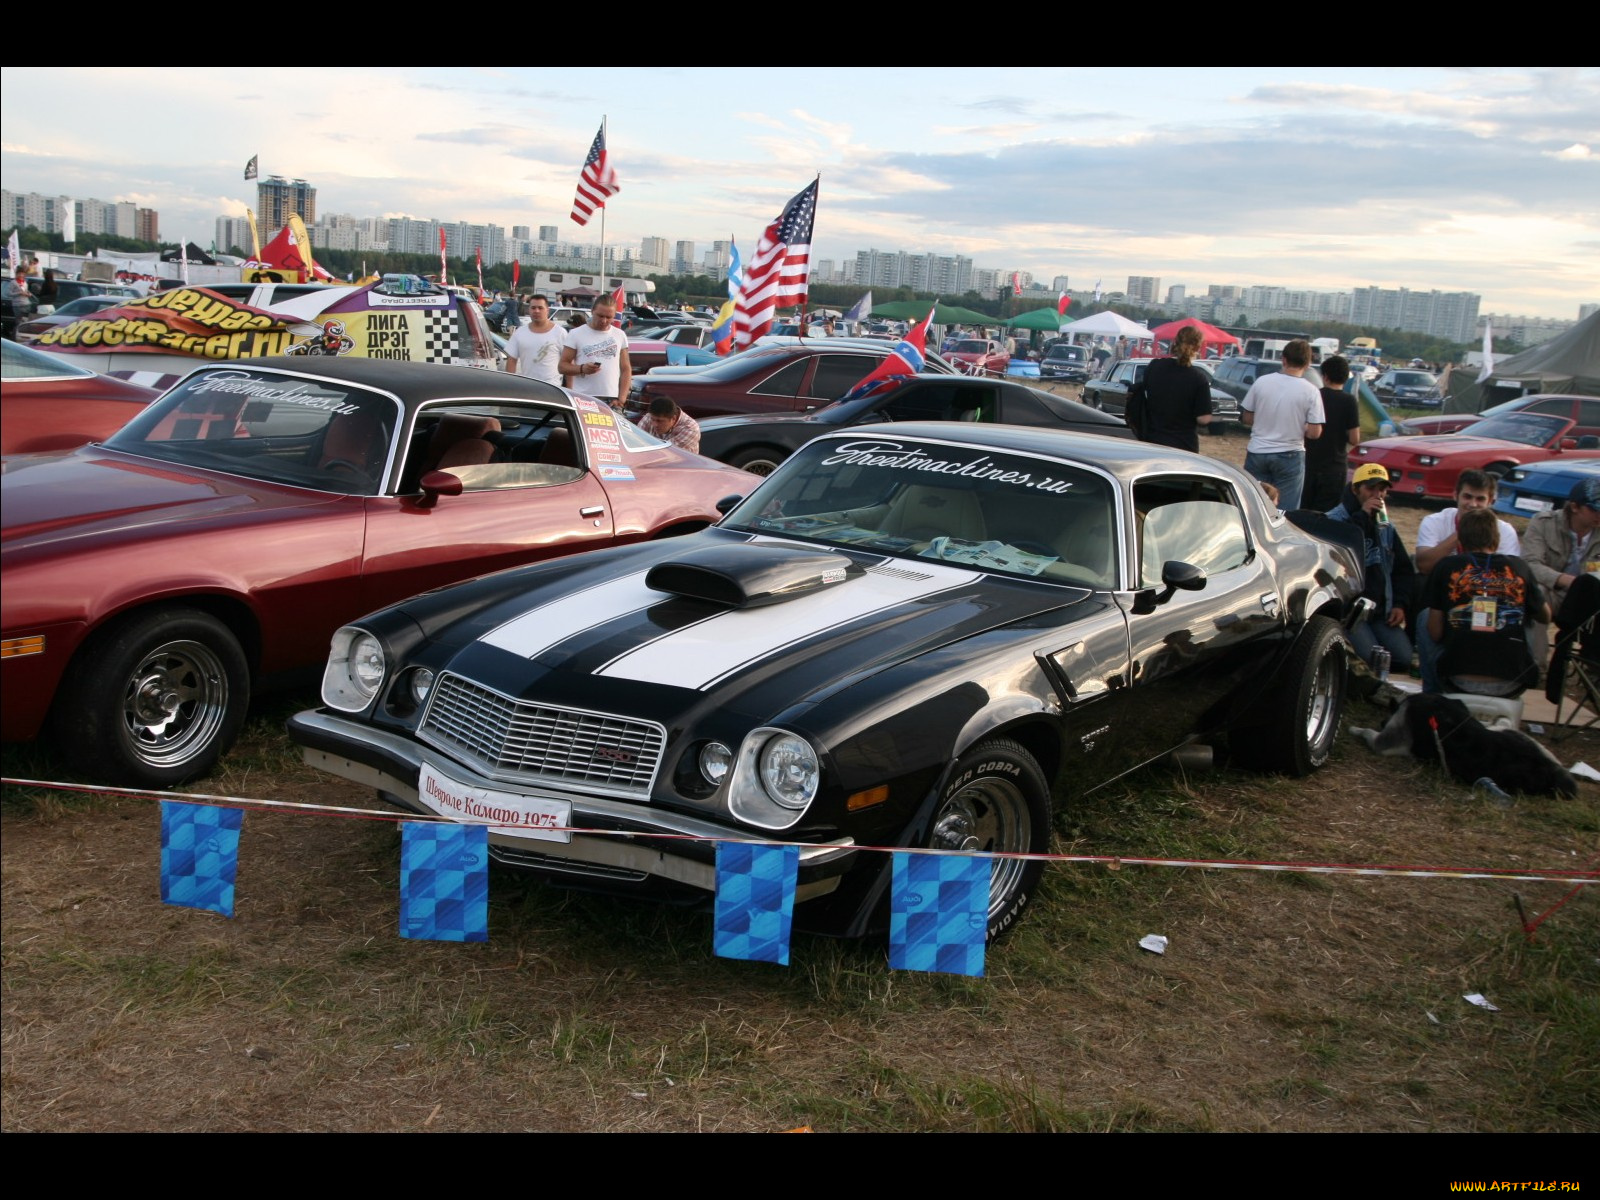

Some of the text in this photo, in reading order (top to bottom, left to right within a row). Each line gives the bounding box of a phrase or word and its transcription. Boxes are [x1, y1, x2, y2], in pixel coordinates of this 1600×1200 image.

[366, 314, 409, 331] ЛИГА
[366, 331, 409, 348] ДРЭГ
[367, 348, 411, 362] ГОНОК
[188, 370, 360, 415] Streetmachines.ru
[589, 428, 618, 444] MSD
[821, 440, 1073, 494] Streetmachines.ru
[976, 761, 1021, 777] COBRA
[425, 775, 462, 811] Шевроле
[464, 796, 520, 825] Камаро
